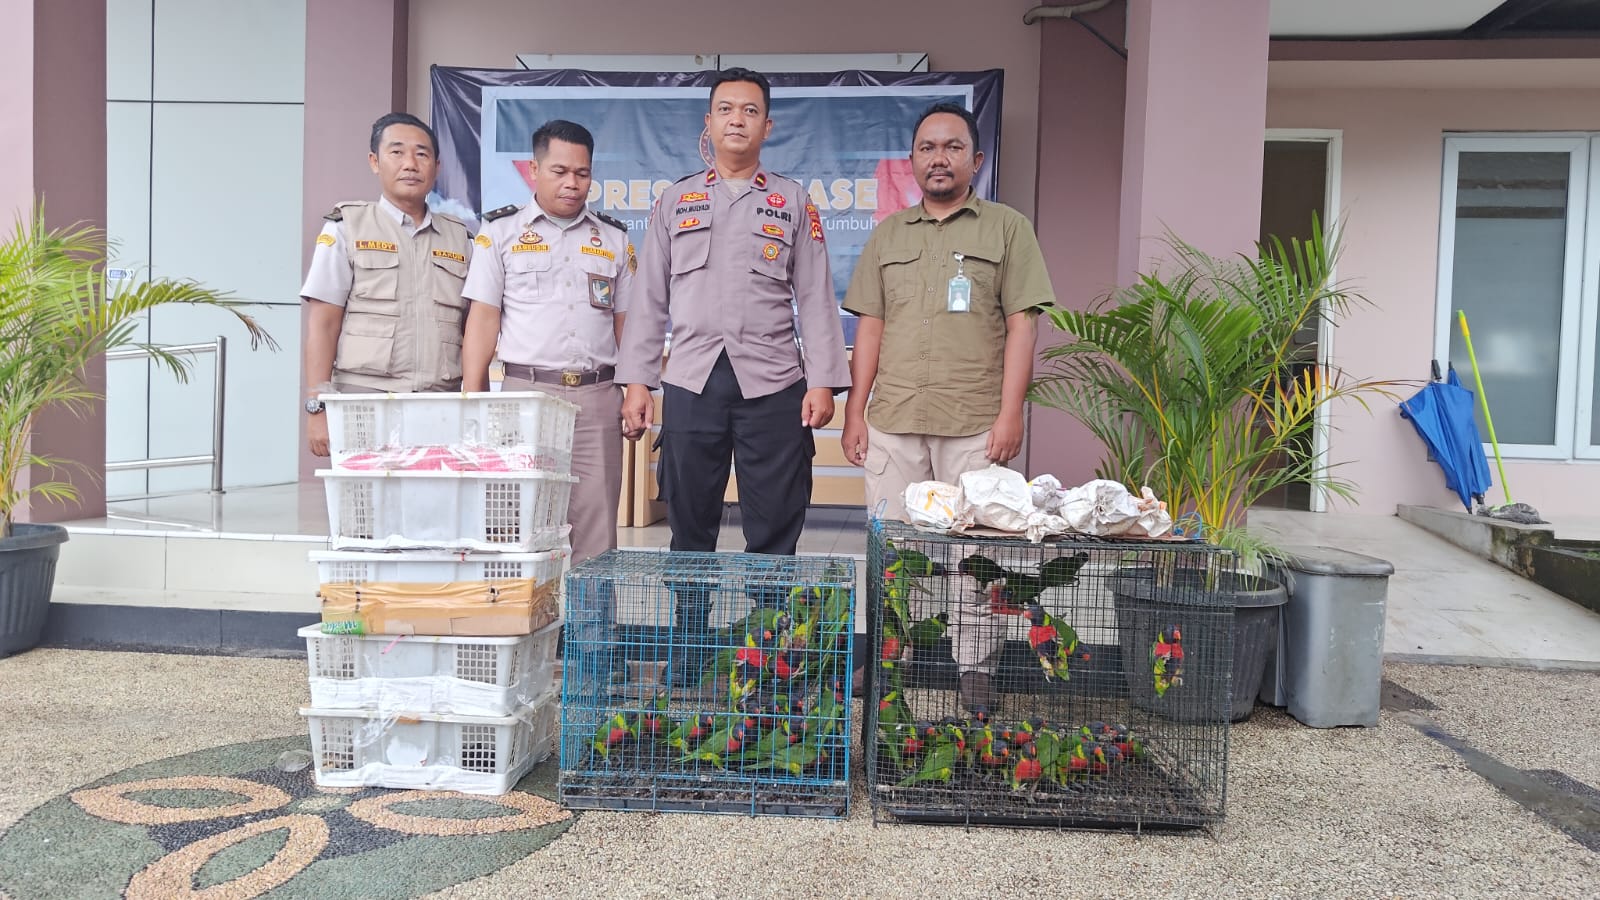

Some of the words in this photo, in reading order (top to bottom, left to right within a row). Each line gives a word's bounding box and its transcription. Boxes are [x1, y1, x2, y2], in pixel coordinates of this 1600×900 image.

[587, 178, 673, 211] PRES
[800, 178, 878, 211] ASE
[622, 216, 648, 230] rant
[820, 216, 878, 230] Tumbuh
[757, 208, 791, 223] POLRI
